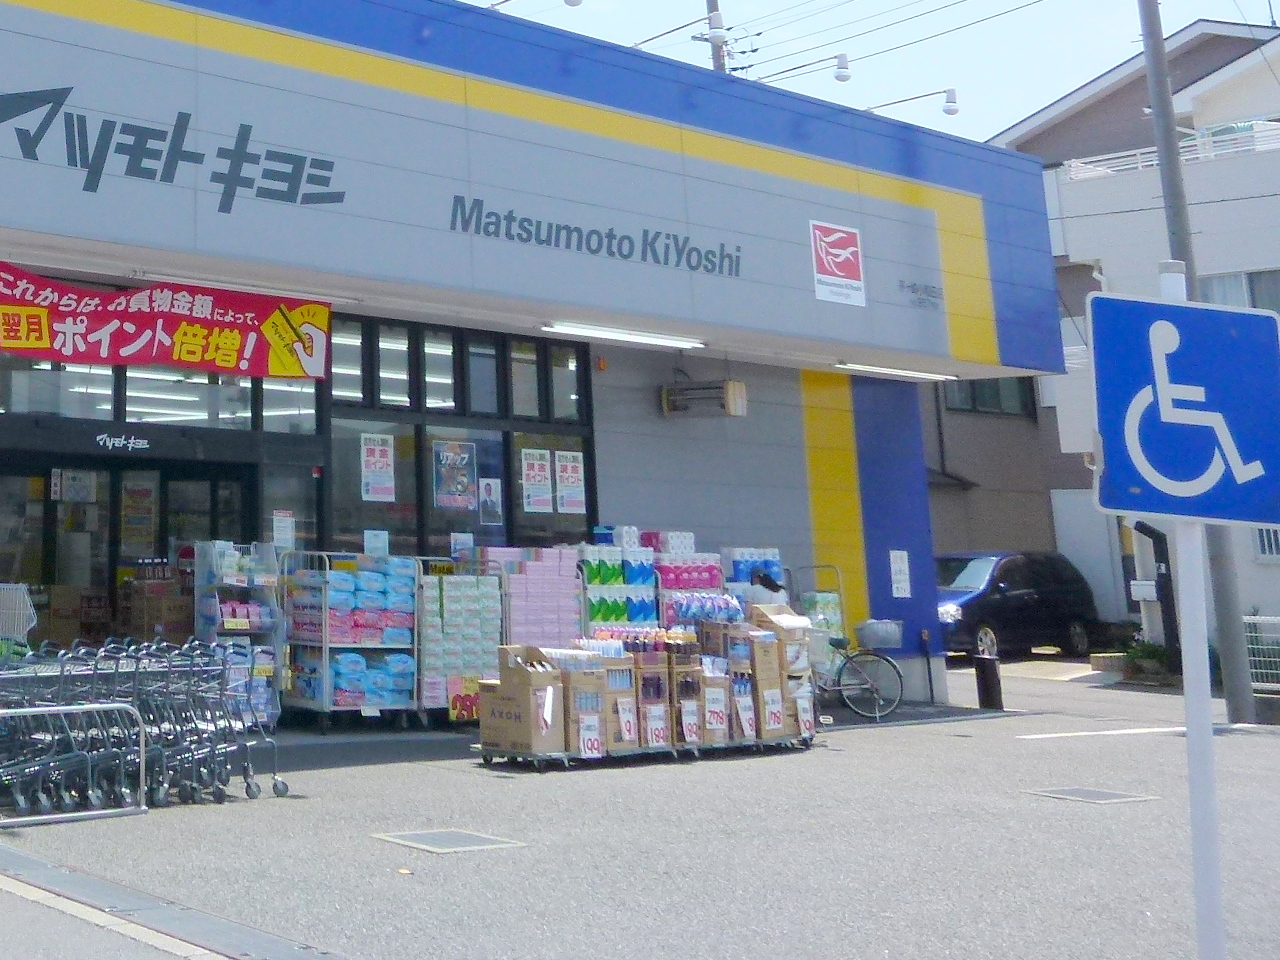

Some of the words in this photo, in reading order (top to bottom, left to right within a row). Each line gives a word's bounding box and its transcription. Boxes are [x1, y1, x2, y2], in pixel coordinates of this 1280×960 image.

[450, 194, 635, 260] Matsumoto
[641, 228, 742, 277] KiYoshi
[2, 312, 43, 342] 翌月
